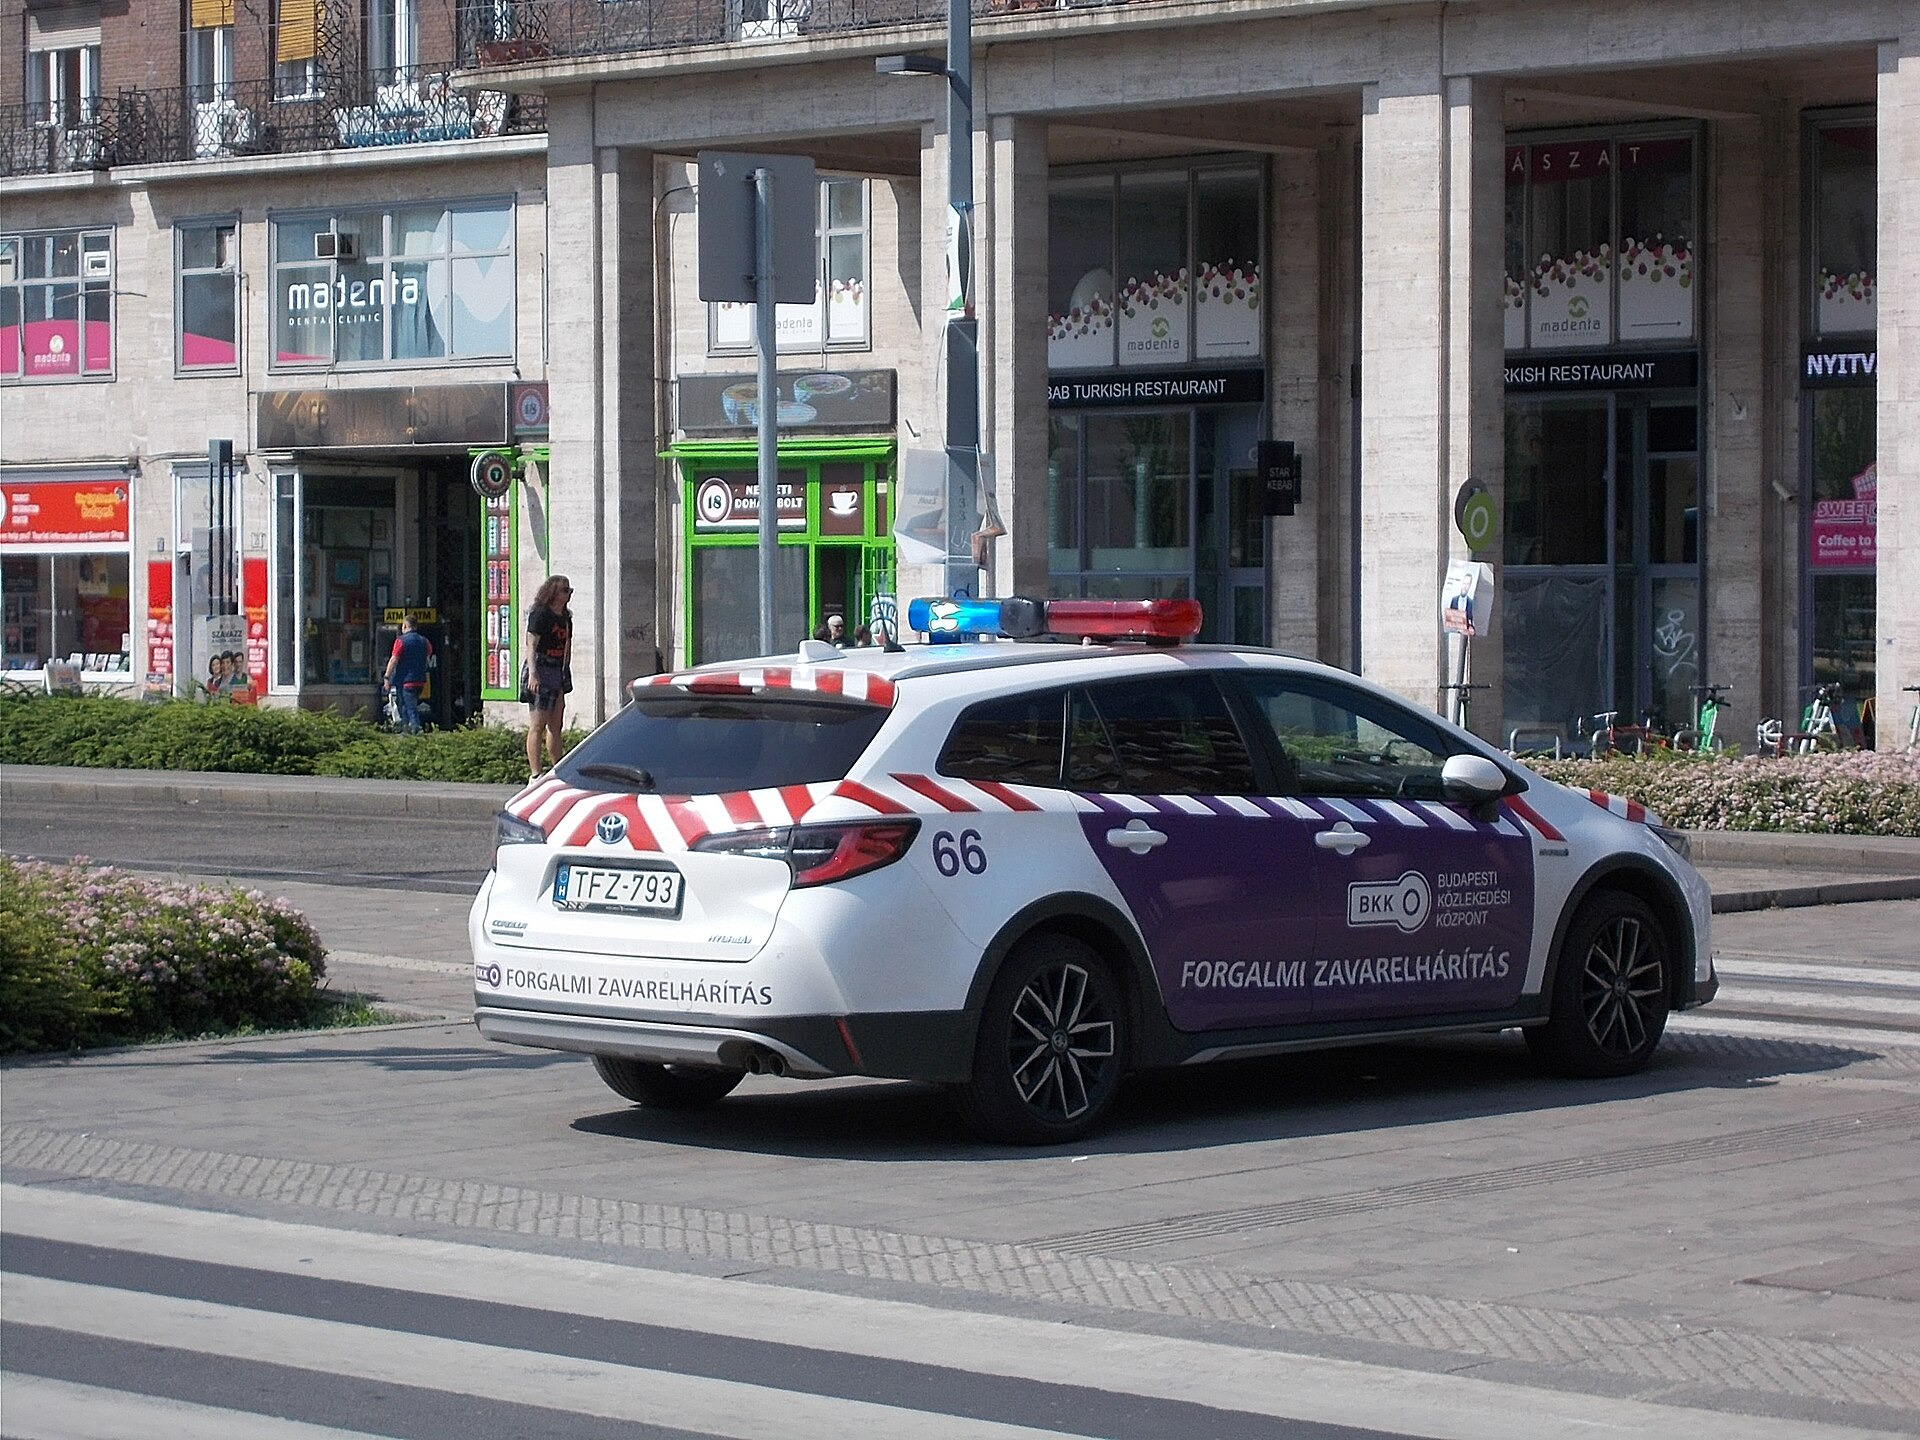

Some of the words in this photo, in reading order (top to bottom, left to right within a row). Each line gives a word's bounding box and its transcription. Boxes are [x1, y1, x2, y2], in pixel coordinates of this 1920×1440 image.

[289, 270, 419, 310] madenta
[289, 316, 332, 326] DENTAL
[338, 313, 380, 324] CLINIC
[1540, 319, 1601, 332] madenta
[1127, 338, 1180, 351] madenta
[34, 352, 71, 363] madenta
[1807, 353, 1876, 375] NYITV
[1550, 363, 1656, 381] RESTAURANT
[1073, 382, 1131, 399] TURKISH
[1135, 379, 1227, 396] RESTAURANT
[1269, 467, 1291, 478] STAR
[707, 496, 722, 509] 18
[1817, 501, 1876, 516] SWEET
[1818, 534, 1856, 546] Coffee
[1859, 535, 1871, 546] to
[386, 611, 403, 620] ATM
[932, 829, 987, 877] 66
[575, 871, 673, 904] TFZ-793
[1438, 871, 1498, 888] BUDAPESTI
[558, 886, 566, 897] H
[1437, 889, 1511, 908] KÖZLEKEDÉSI
[1359, 895, 1394, 913] BKK
[1436, 911, 1489, 927] KÖZPONT
[1181, 957, 1305, 988] FORGALMI
[1313, 946, 1511, 986] ZAVARELHÁRÍTÁS
[507, 968, 592, 995] FORGALMI
[598, 977, 773, 1006] ZAVARELHÁRÍTÁS
